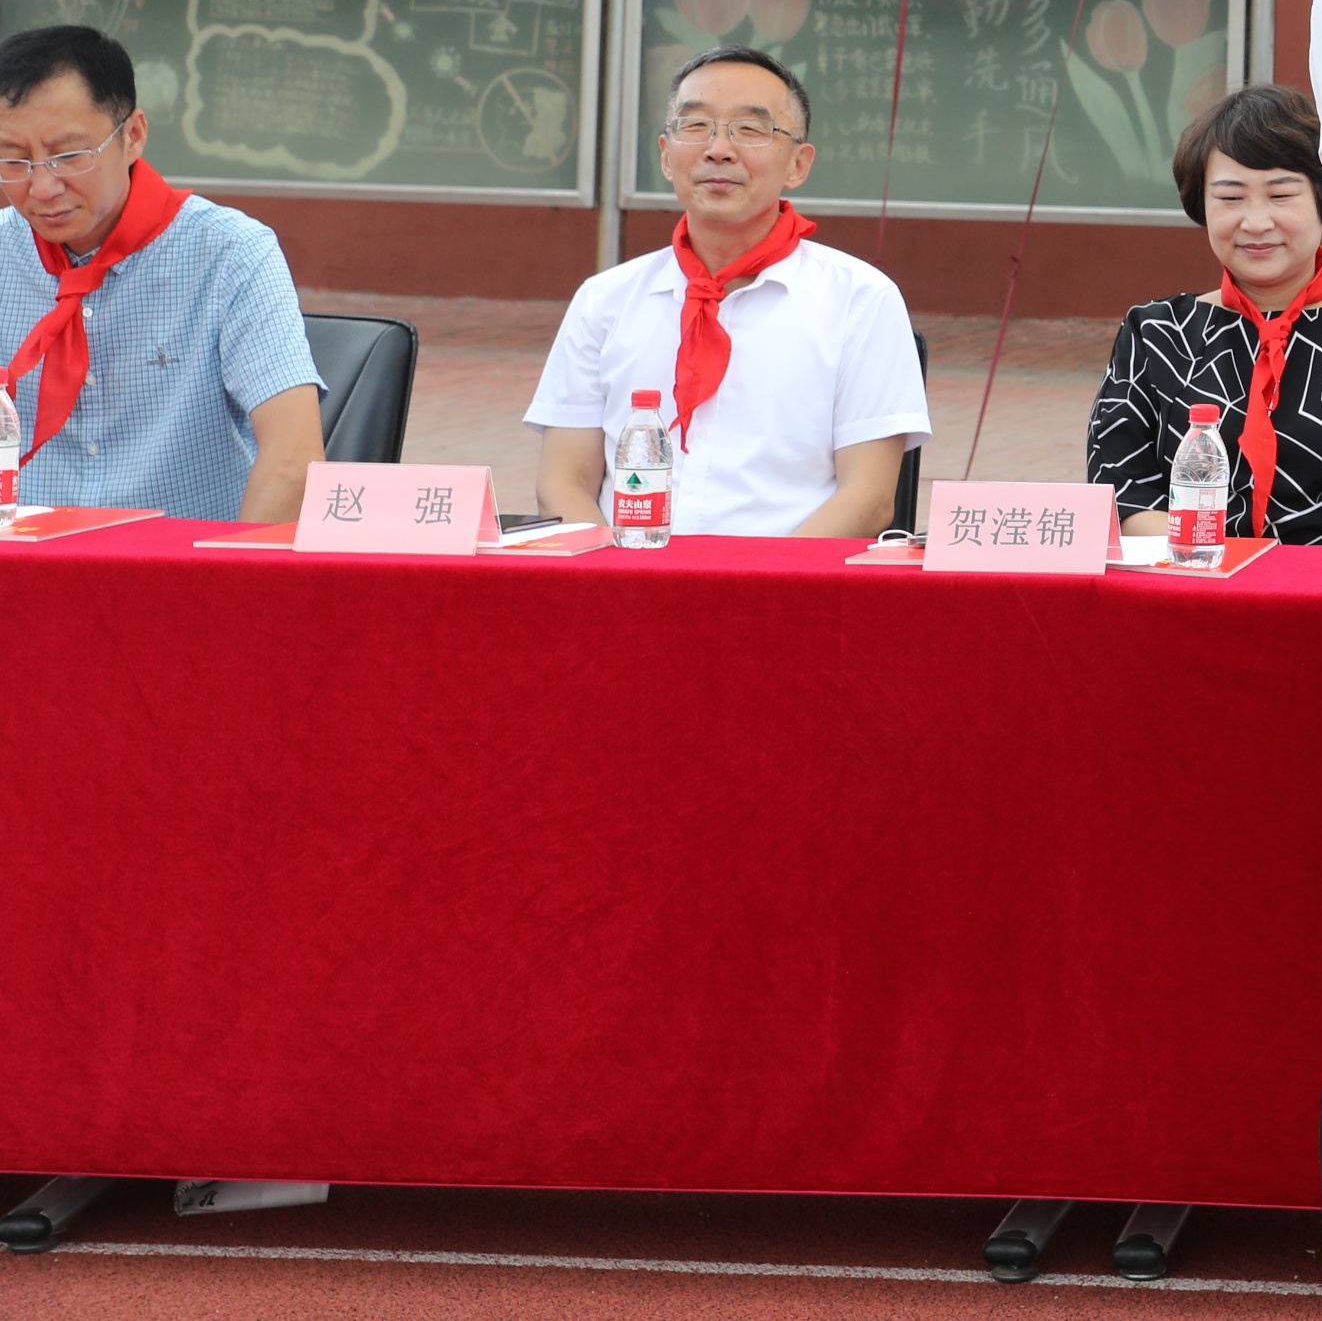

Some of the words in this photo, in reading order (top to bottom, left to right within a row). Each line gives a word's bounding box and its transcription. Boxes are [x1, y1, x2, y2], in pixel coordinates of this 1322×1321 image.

[322, 482, 454, 526] 赵强
[618, 498, 653, 509] 农夫山泉
[946, 504, 1076, 548] 贺滢锦
